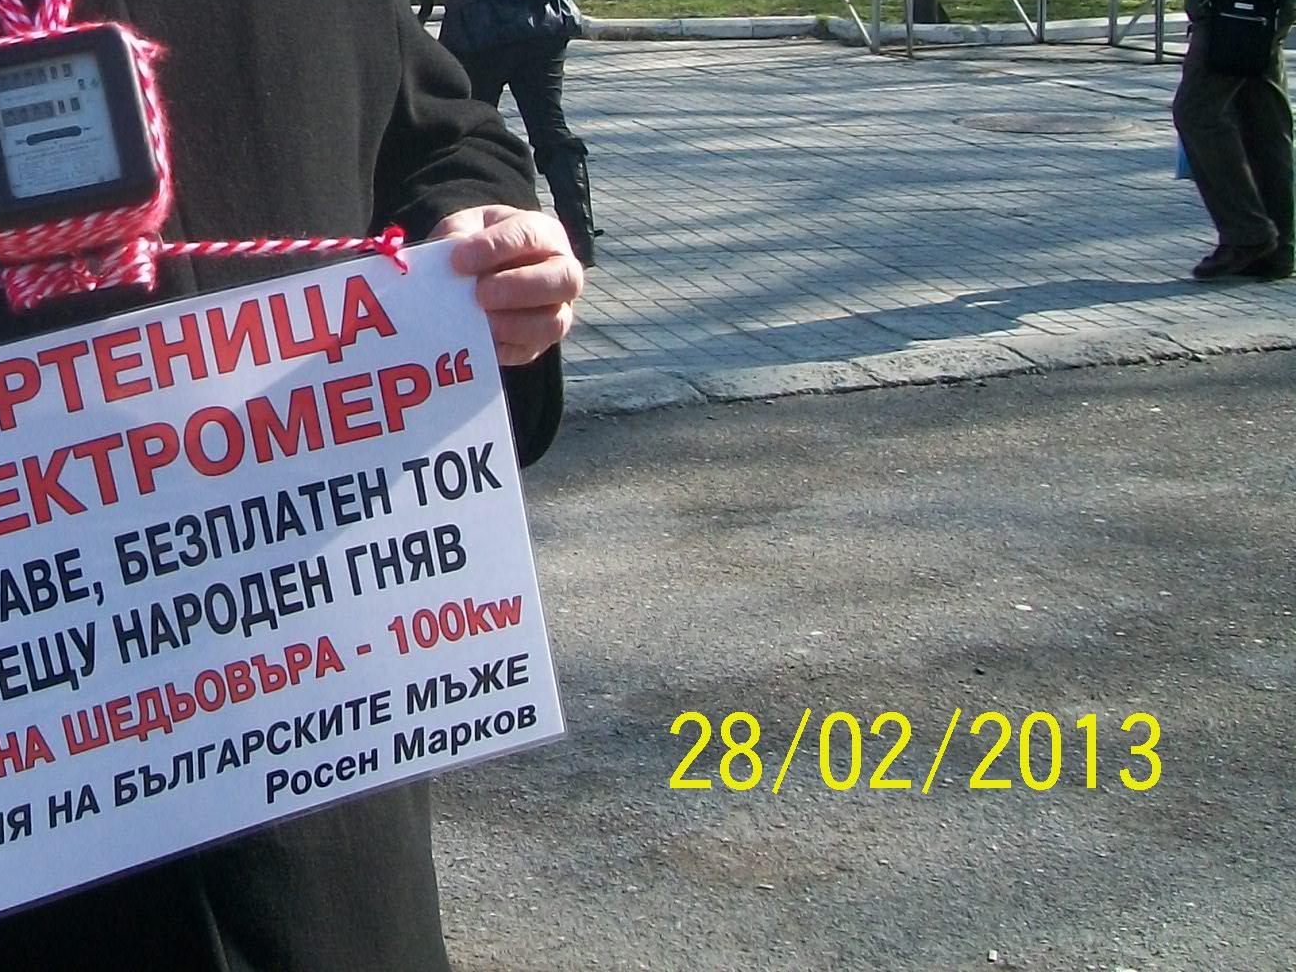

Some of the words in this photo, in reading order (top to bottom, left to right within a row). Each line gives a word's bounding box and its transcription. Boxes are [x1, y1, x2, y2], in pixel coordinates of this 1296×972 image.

[115, 467, 392, 586] БЕЗПЛАТЕН
[402, 442, 502, 506] ТОК
[112, 555, 334, 664] НАРОДЕН
[345, 523, 467, 596] ГНЯВ
[49, 784, 100, 829] НА
[114, 690, 392, 807] БЪЛГАРСКИТЕ
[407, 653, 529, 715] МЪЖЕ
[62, 636, 345, 756] ШЕДЬОВЪРА
[356, 643, 372, 656] -
[388, 595, 523, 655] 100kw
[266, 748, 379, 804] Росен
[394, 704, 537, 765] Марков
